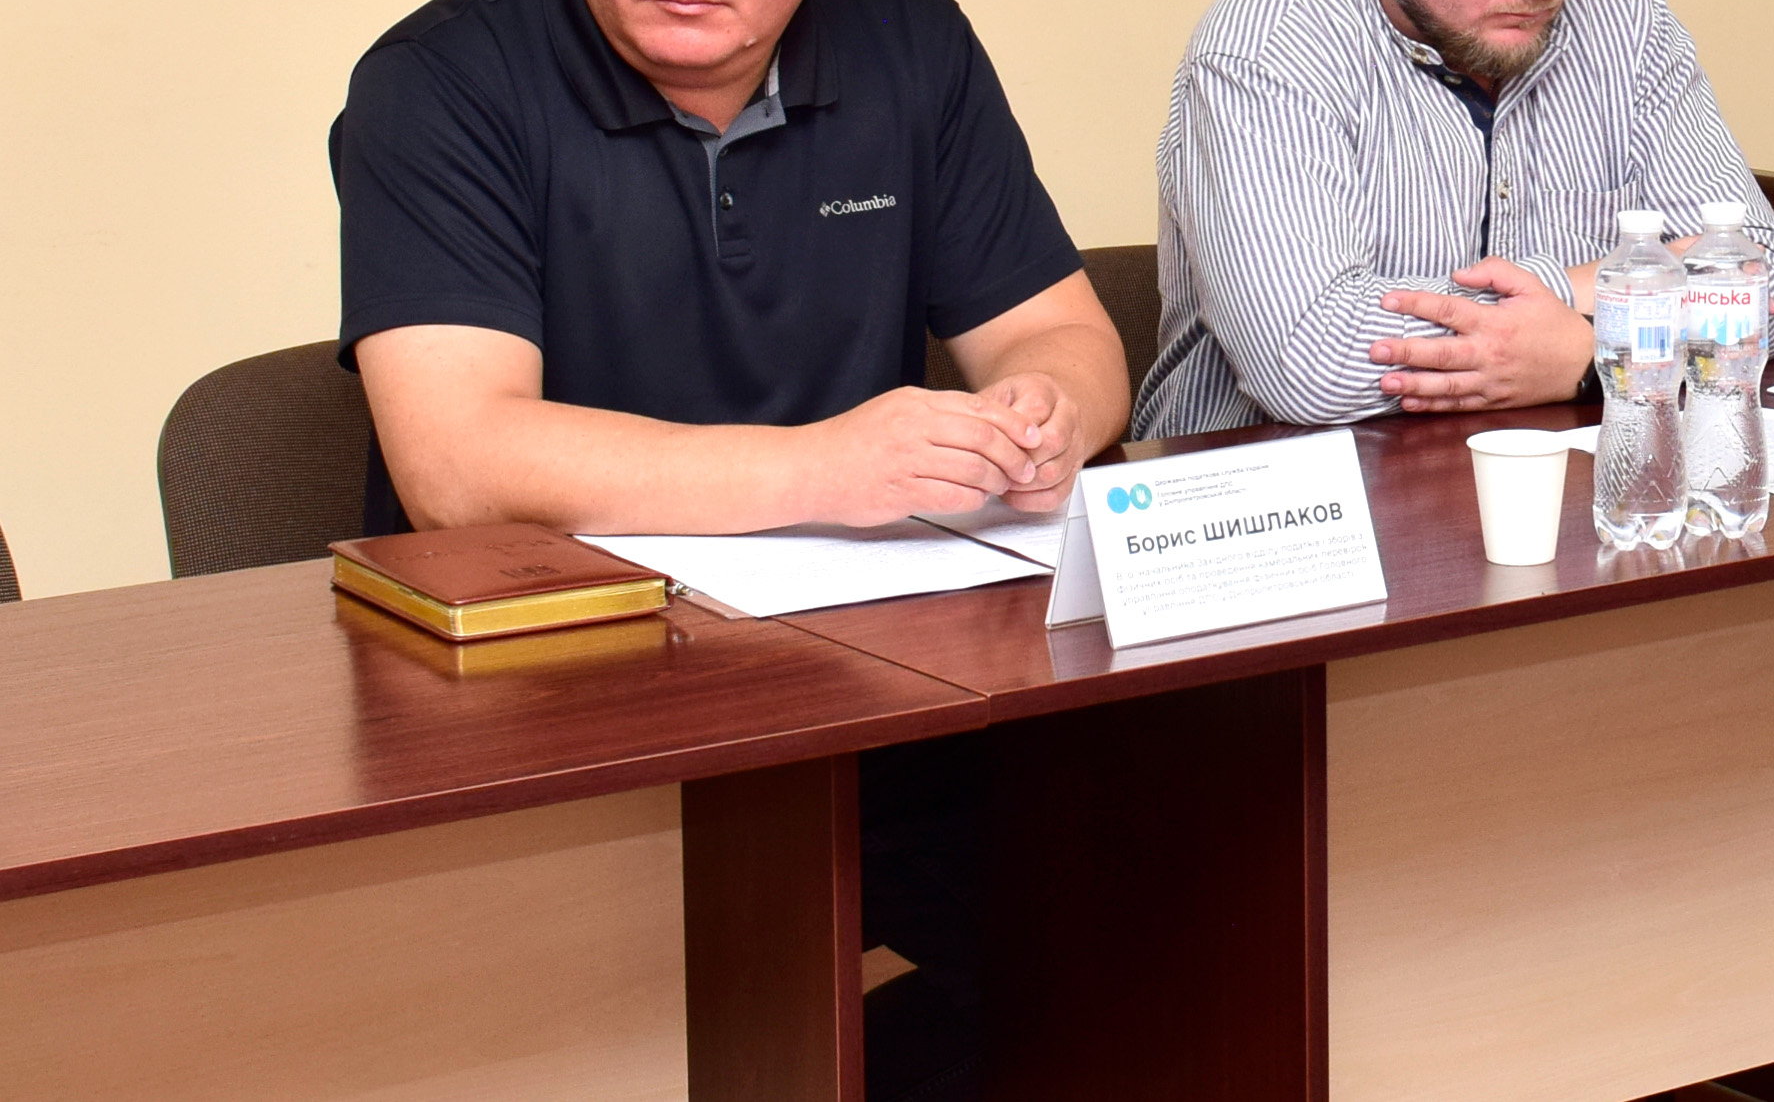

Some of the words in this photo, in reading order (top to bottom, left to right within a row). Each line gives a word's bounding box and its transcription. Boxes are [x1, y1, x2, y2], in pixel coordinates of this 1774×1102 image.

[830, 194, 897, 215] Columbia
[1688, 289, 1750, 305] инська
[1126, 530, 1196, 554] Борис
[1203, 503, 1342, 541] ШИШЛАКОВ
